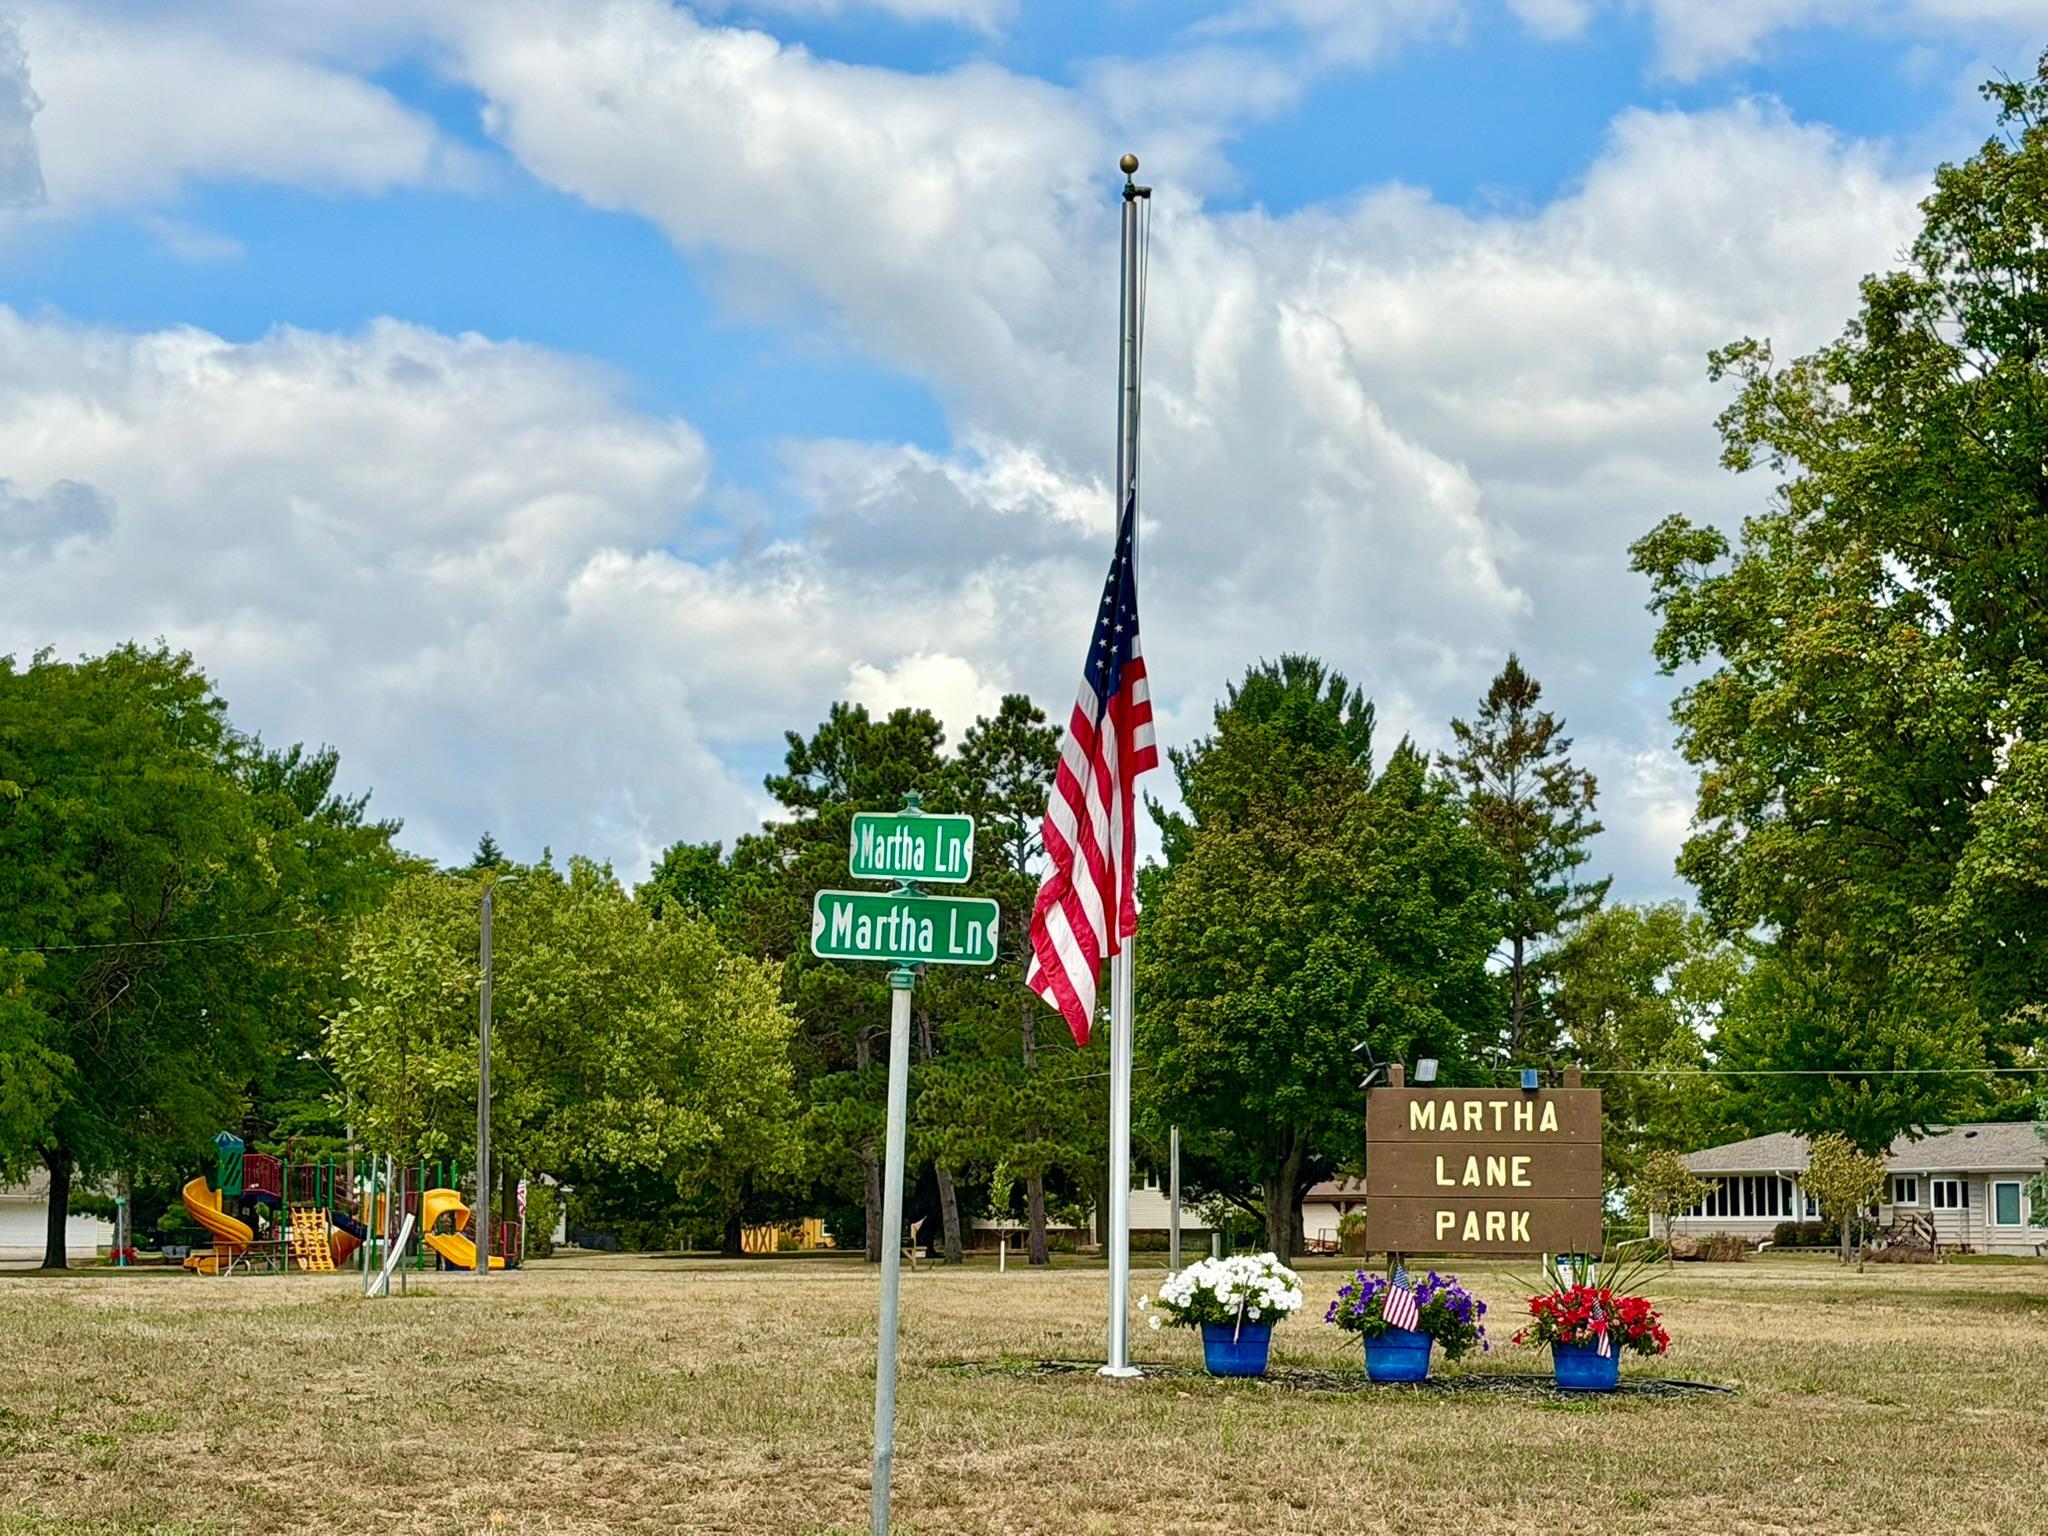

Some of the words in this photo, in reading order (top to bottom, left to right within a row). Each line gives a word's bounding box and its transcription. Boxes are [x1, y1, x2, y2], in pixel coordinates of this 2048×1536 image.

[860, 823, 925, 871] Martha
[935, 825, 961, 873] Ln
[830, 902, 934, 952] Martha
[949, 908, 982, 955] Ln
[1409, 1101, 1558, 1132] MARTHA
[1436, 1156, 1532, 1187] LANE
[1436, 1211, 1530, 1242] PARK
